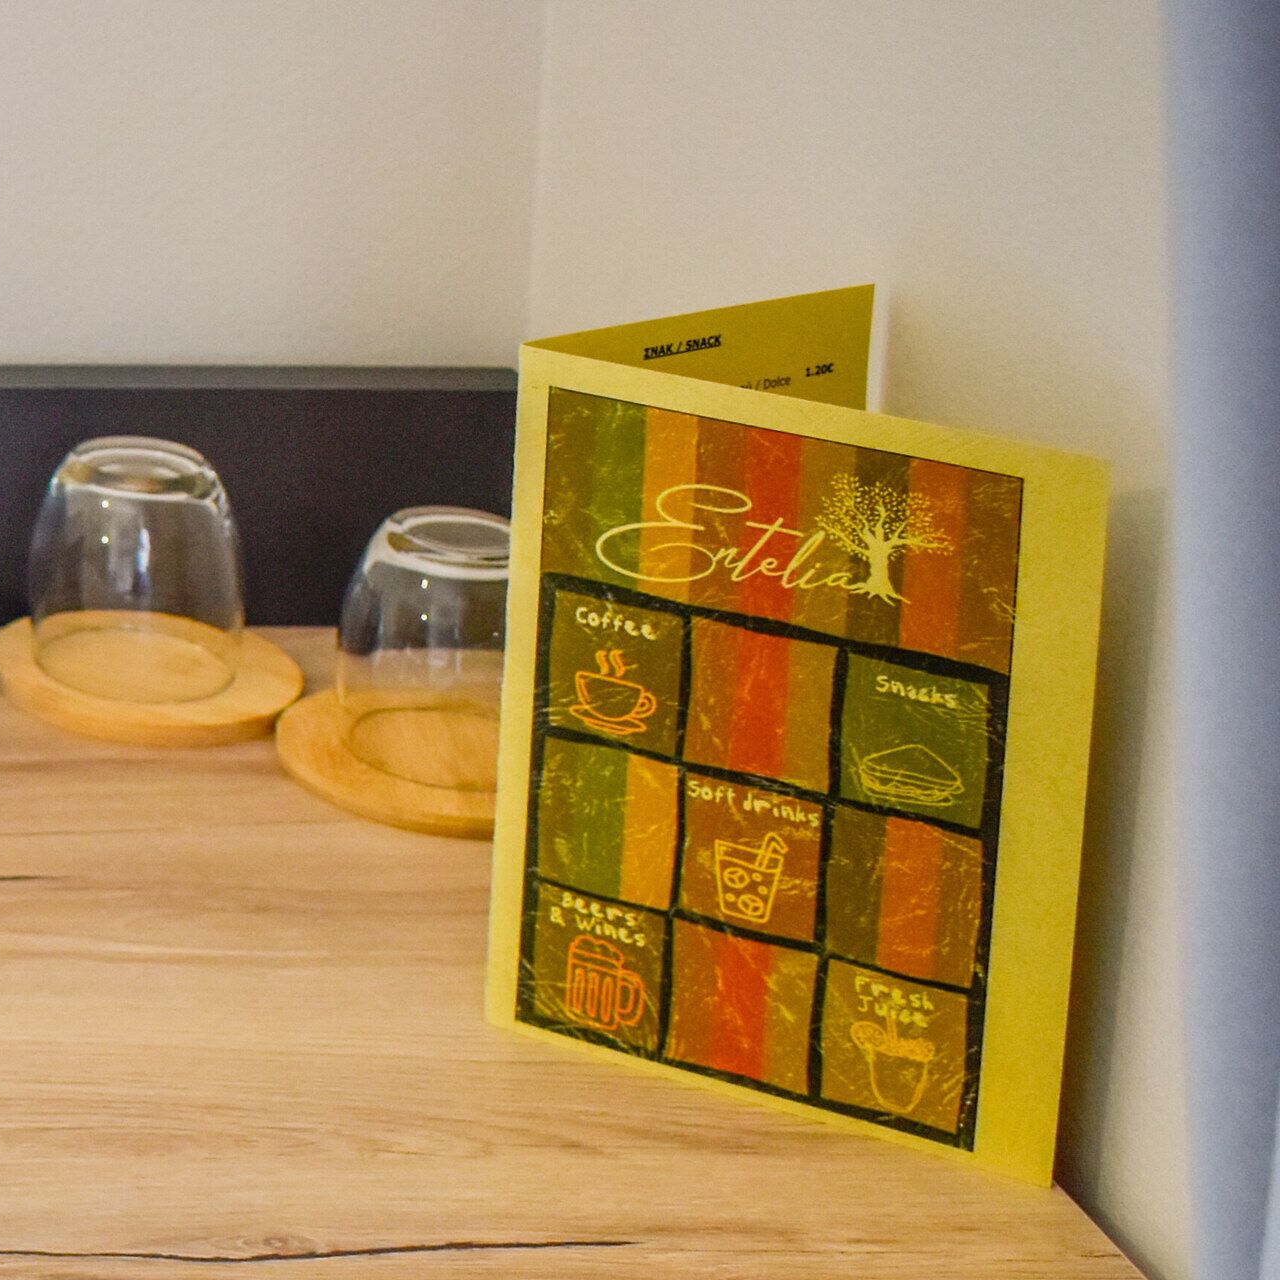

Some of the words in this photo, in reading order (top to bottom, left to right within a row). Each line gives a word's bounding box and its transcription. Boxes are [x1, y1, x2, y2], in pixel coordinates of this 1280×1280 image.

[685, 334, 723, 352] SNACK
[763, 376, 791, 390] Dolce
[575, 606, 658, 641] Coffee
[688, 780, 737, 804] Soft
[743, 790, 820, 828] drinks
[562, 892, 638, 928] Beers
[575, 913, 646, 948] Wines
[855, 975, 935, 1011] Fresh
